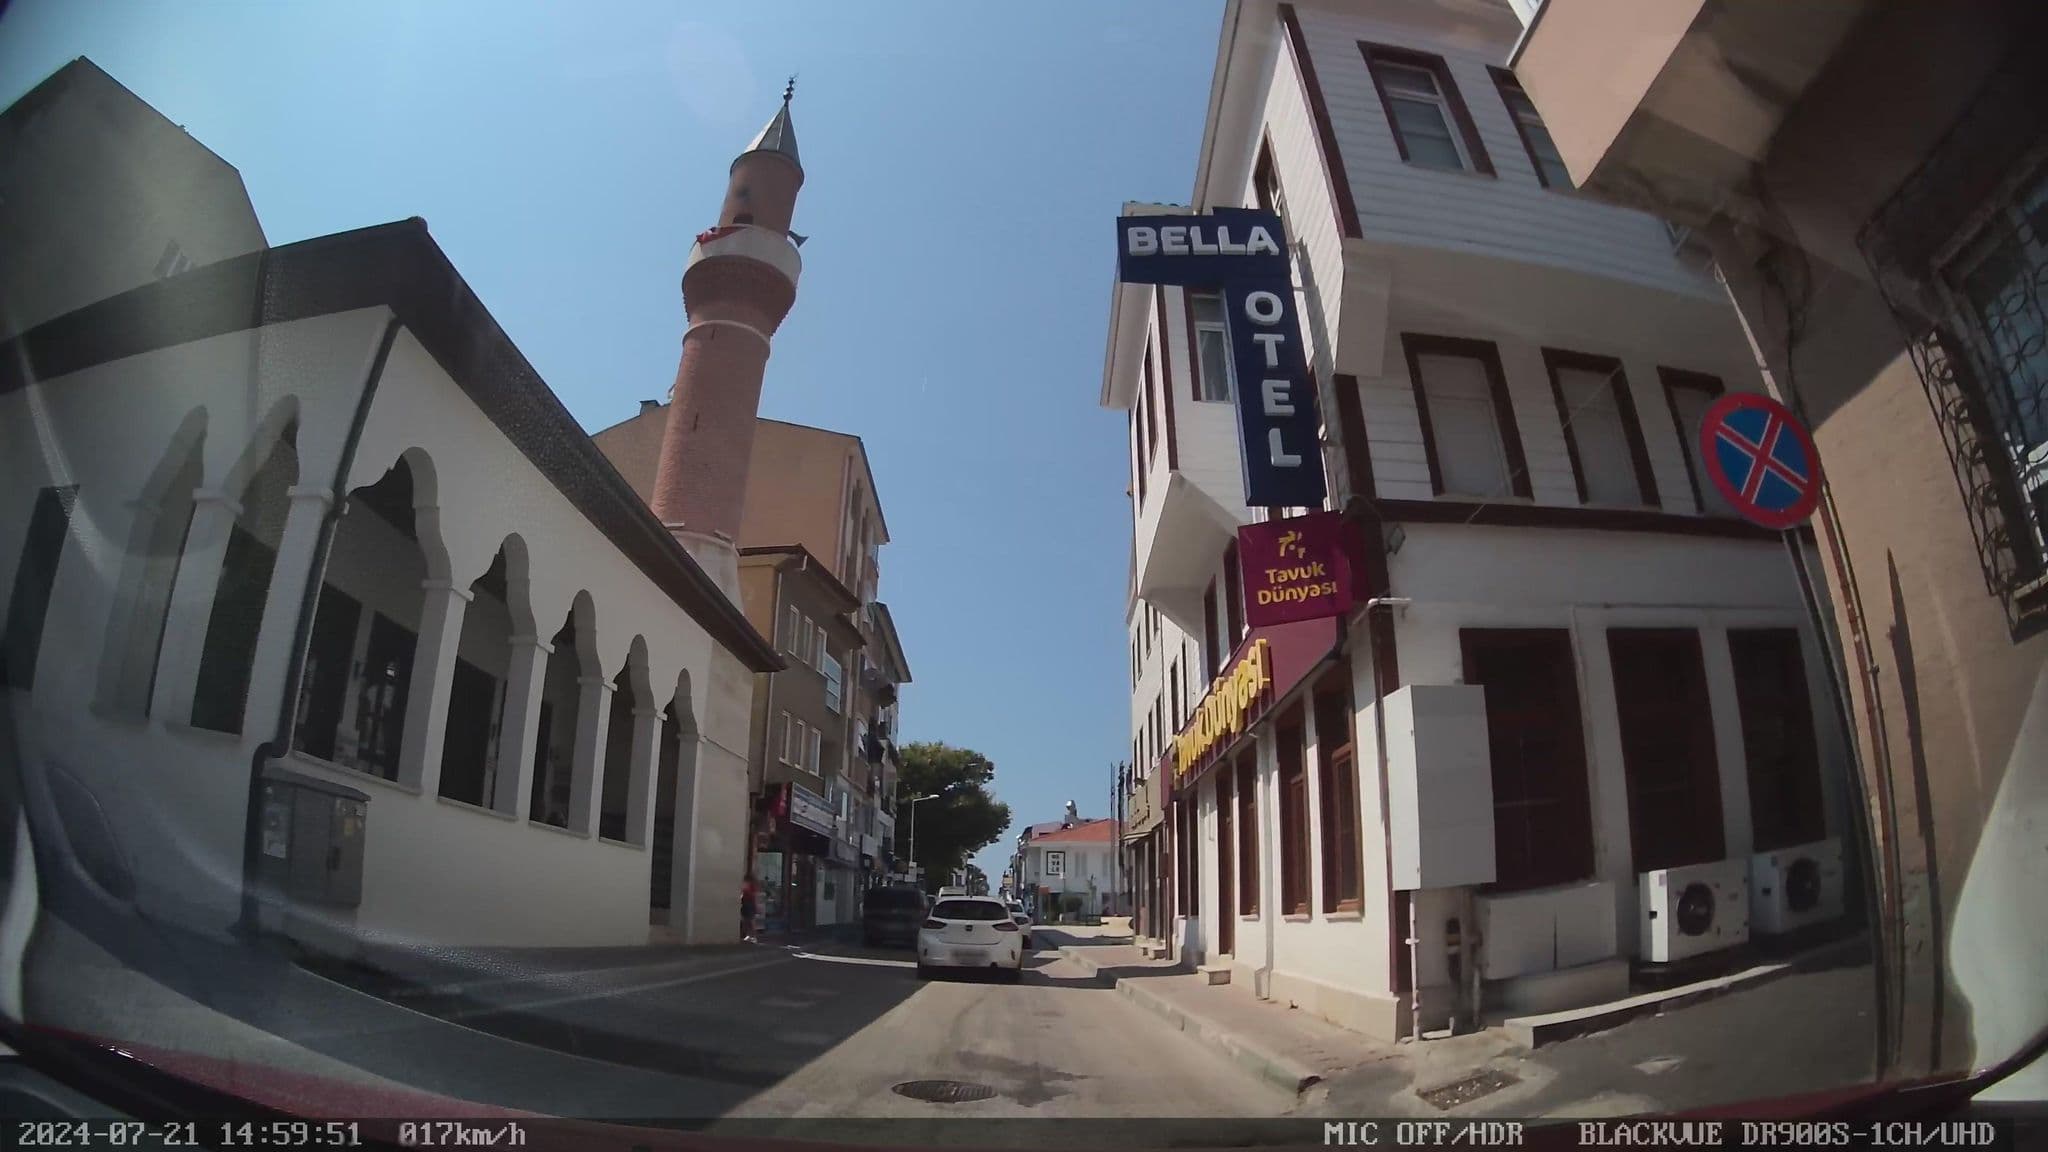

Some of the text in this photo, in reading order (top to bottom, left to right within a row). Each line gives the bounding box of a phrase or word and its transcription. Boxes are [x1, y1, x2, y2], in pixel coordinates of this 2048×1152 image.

[1127, 226, 1280, 256] BELLA
[1245, 291, 1301, 467] OTEL
[1265, 561, 1326, 584] Tavuk
[1257, 581, 1338, 605] Dünyası
